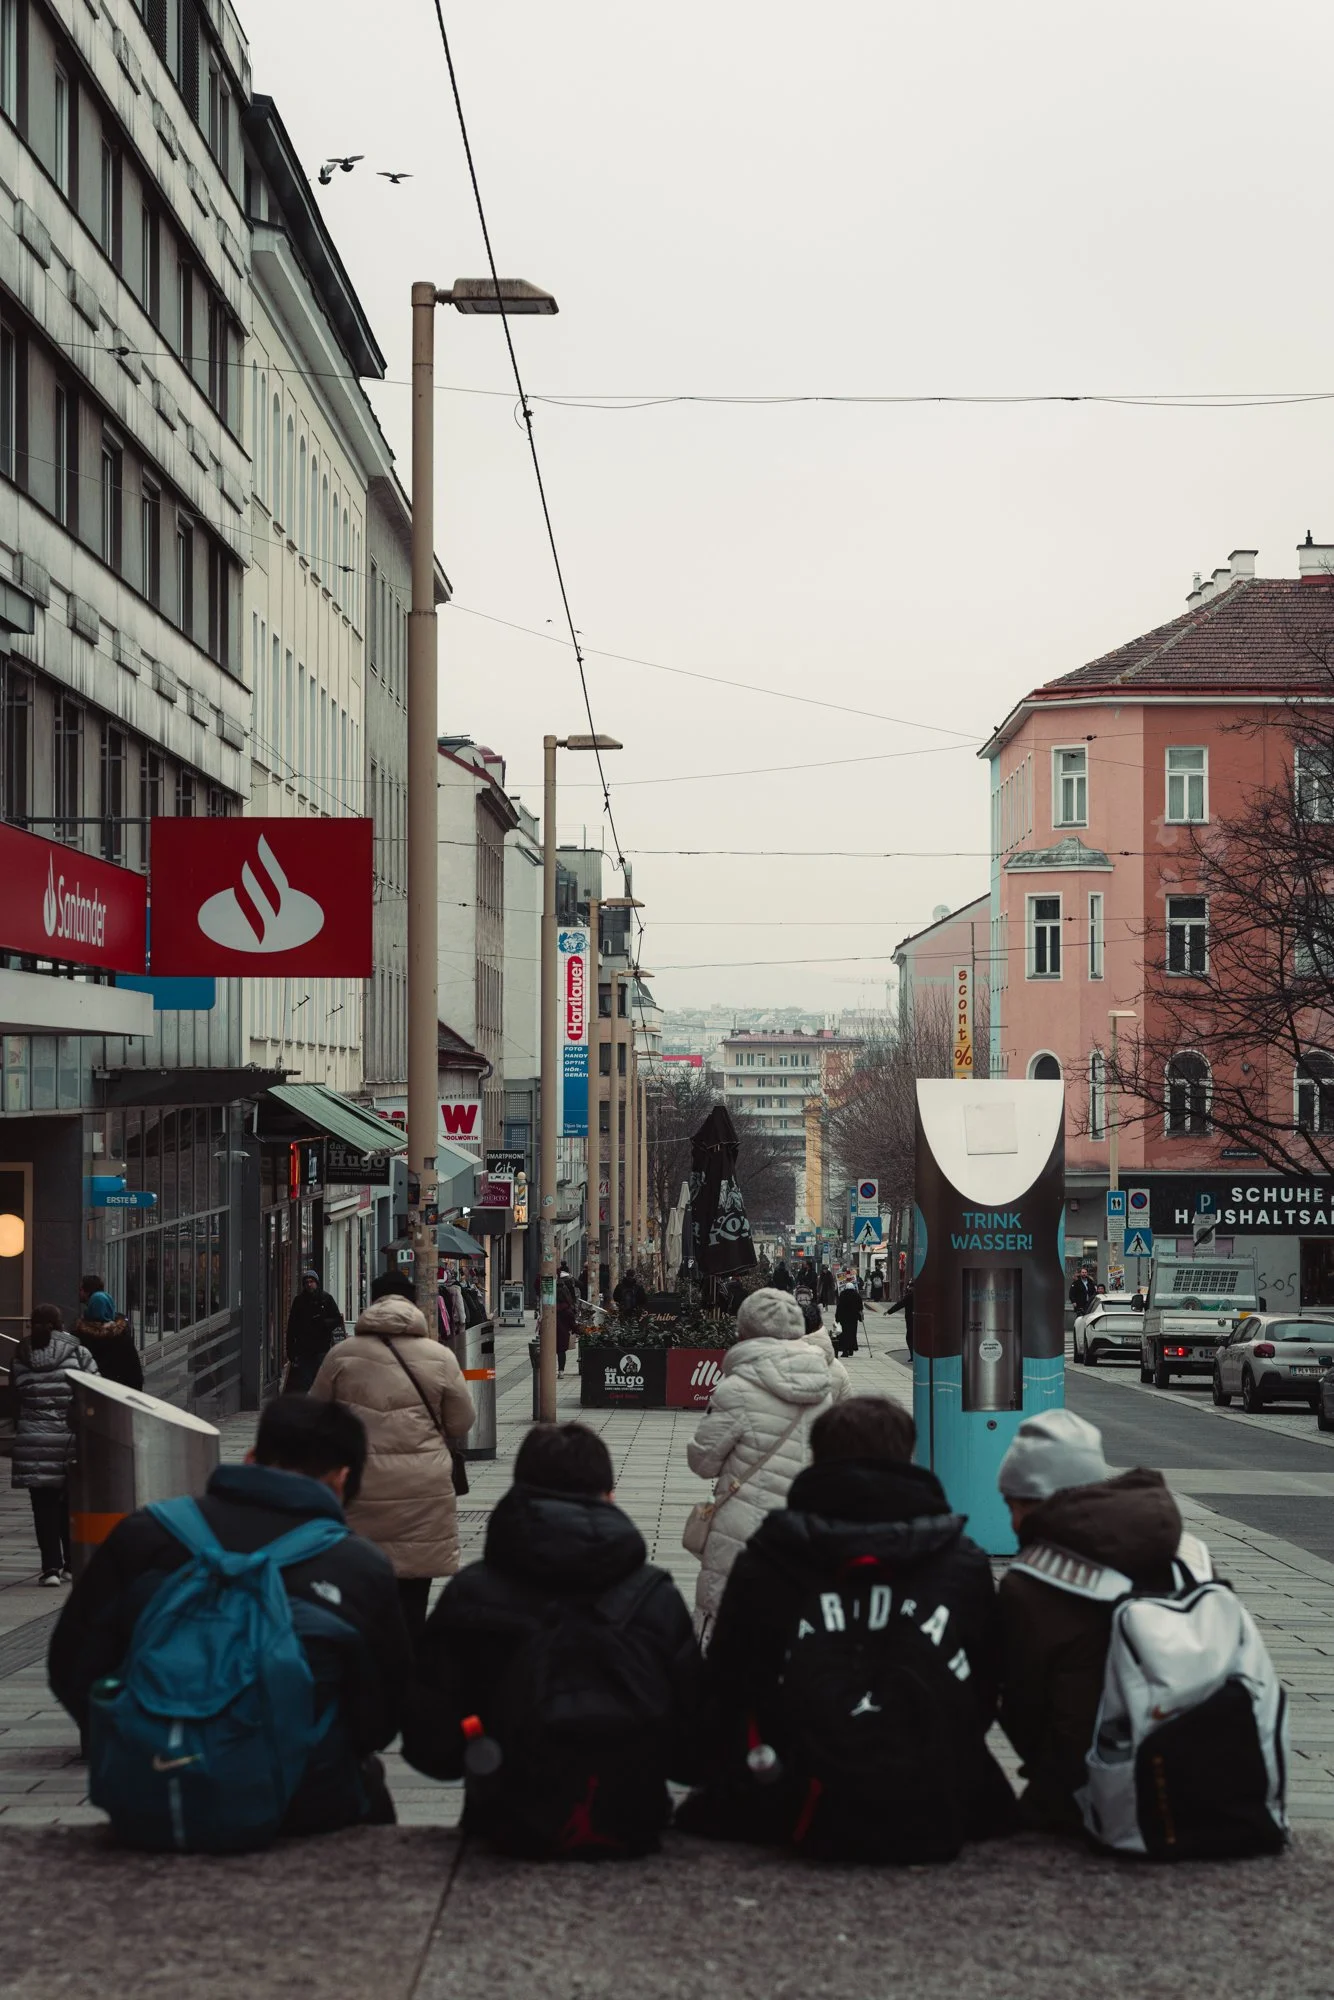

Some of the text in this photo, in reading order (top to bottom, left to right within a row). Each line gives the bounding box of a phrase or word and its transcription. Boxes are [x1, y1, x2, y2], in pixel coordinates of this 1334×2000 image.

[57, 874, 107, 948] Santander
[568, 960, 583, 1036] Hartlauer
[441, 1104, 478, 1134] W
[328, 1150, 386, 1172] Hugo
[495, 1161, 517, 1174] City
[106, 1196, 129, 1204] ERSTE
[1200, 1194, 1211, 1213] P
[1231, 1187, 1324, 1203] SCHUHE
[962, 1212, 1022, 1230] TRINK
[951, 1234, 1033, 1251] WASSER!
[604, 1372, 644, 1388] Hugo
